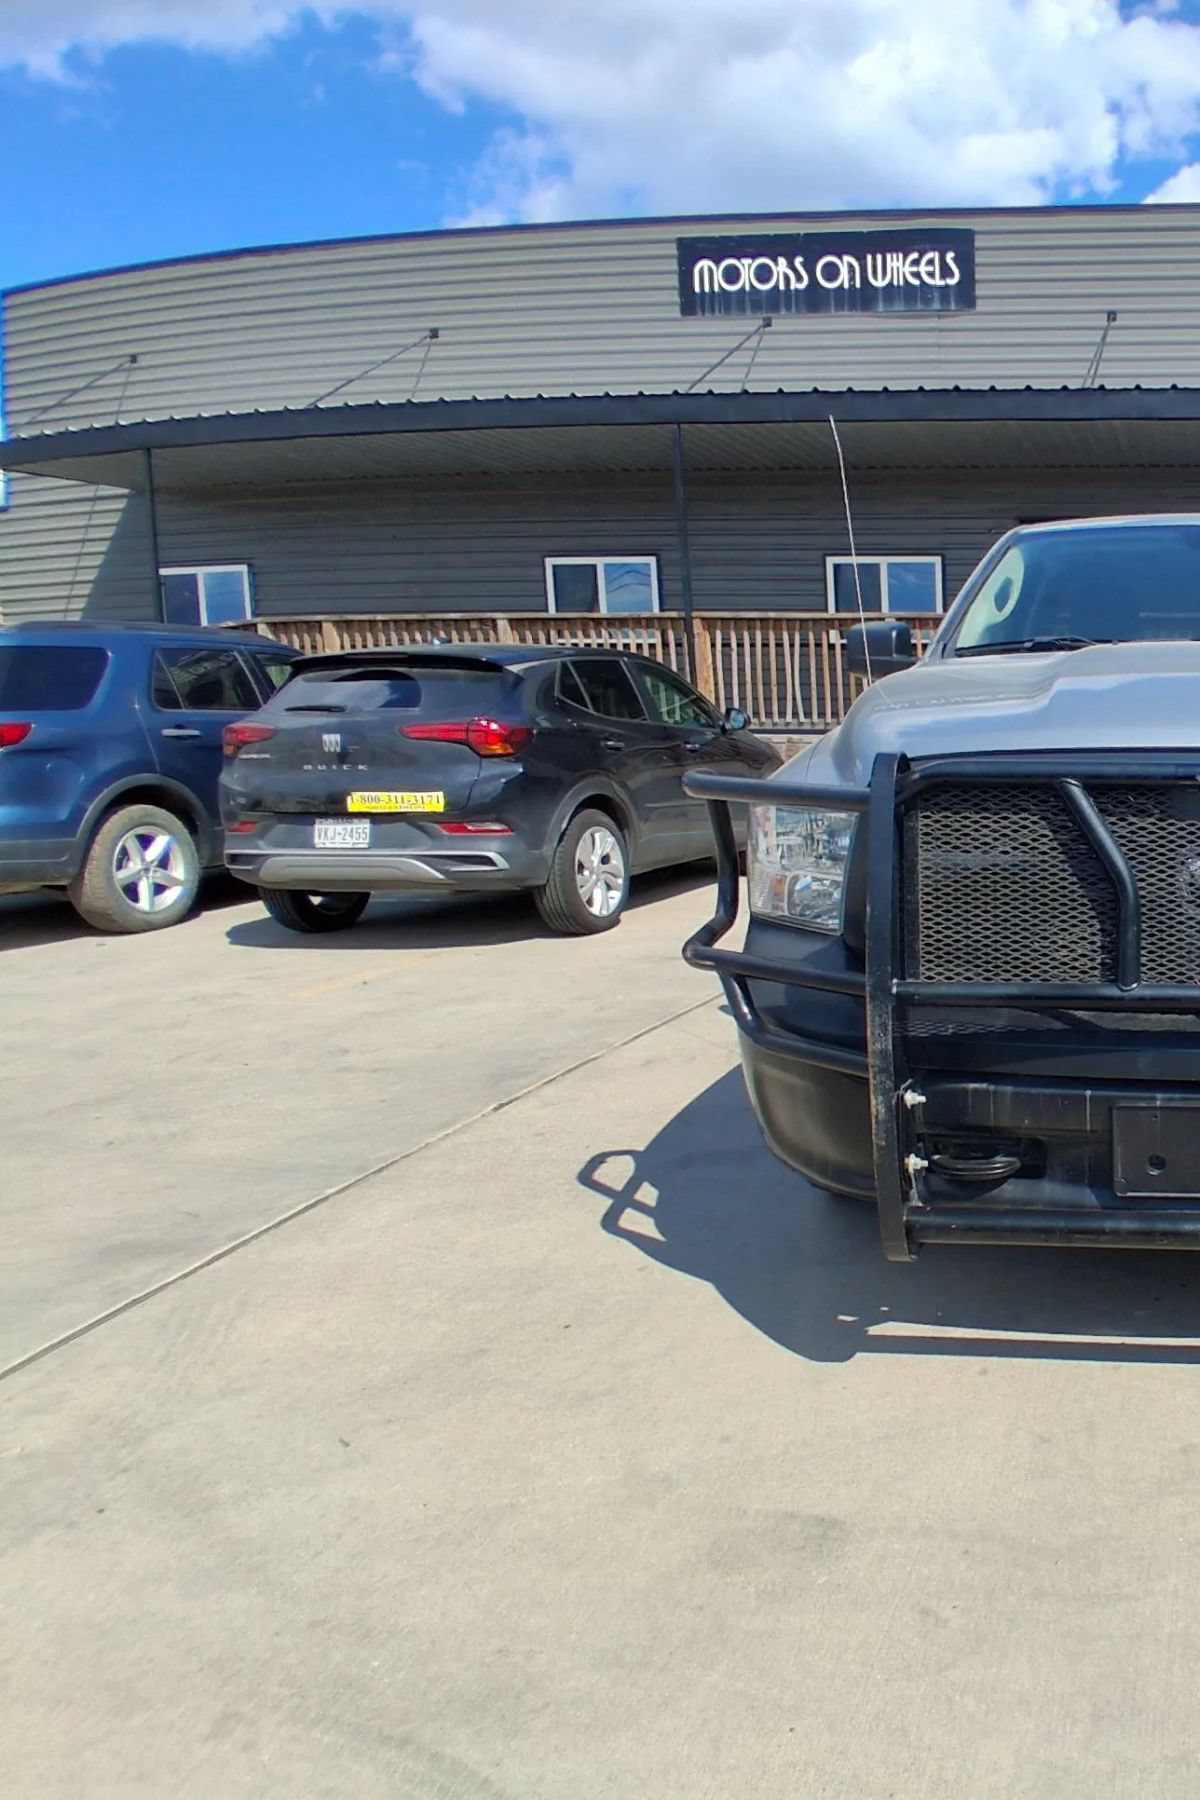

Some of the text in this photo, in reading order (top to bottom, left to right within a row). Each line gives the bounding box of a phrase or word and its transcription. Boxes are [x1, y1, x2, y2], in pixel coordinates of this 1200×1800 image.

[694, 250, 961, 292] MOTORS ON WHEELS
[317, 826, 368, 842] VKJ-2455
